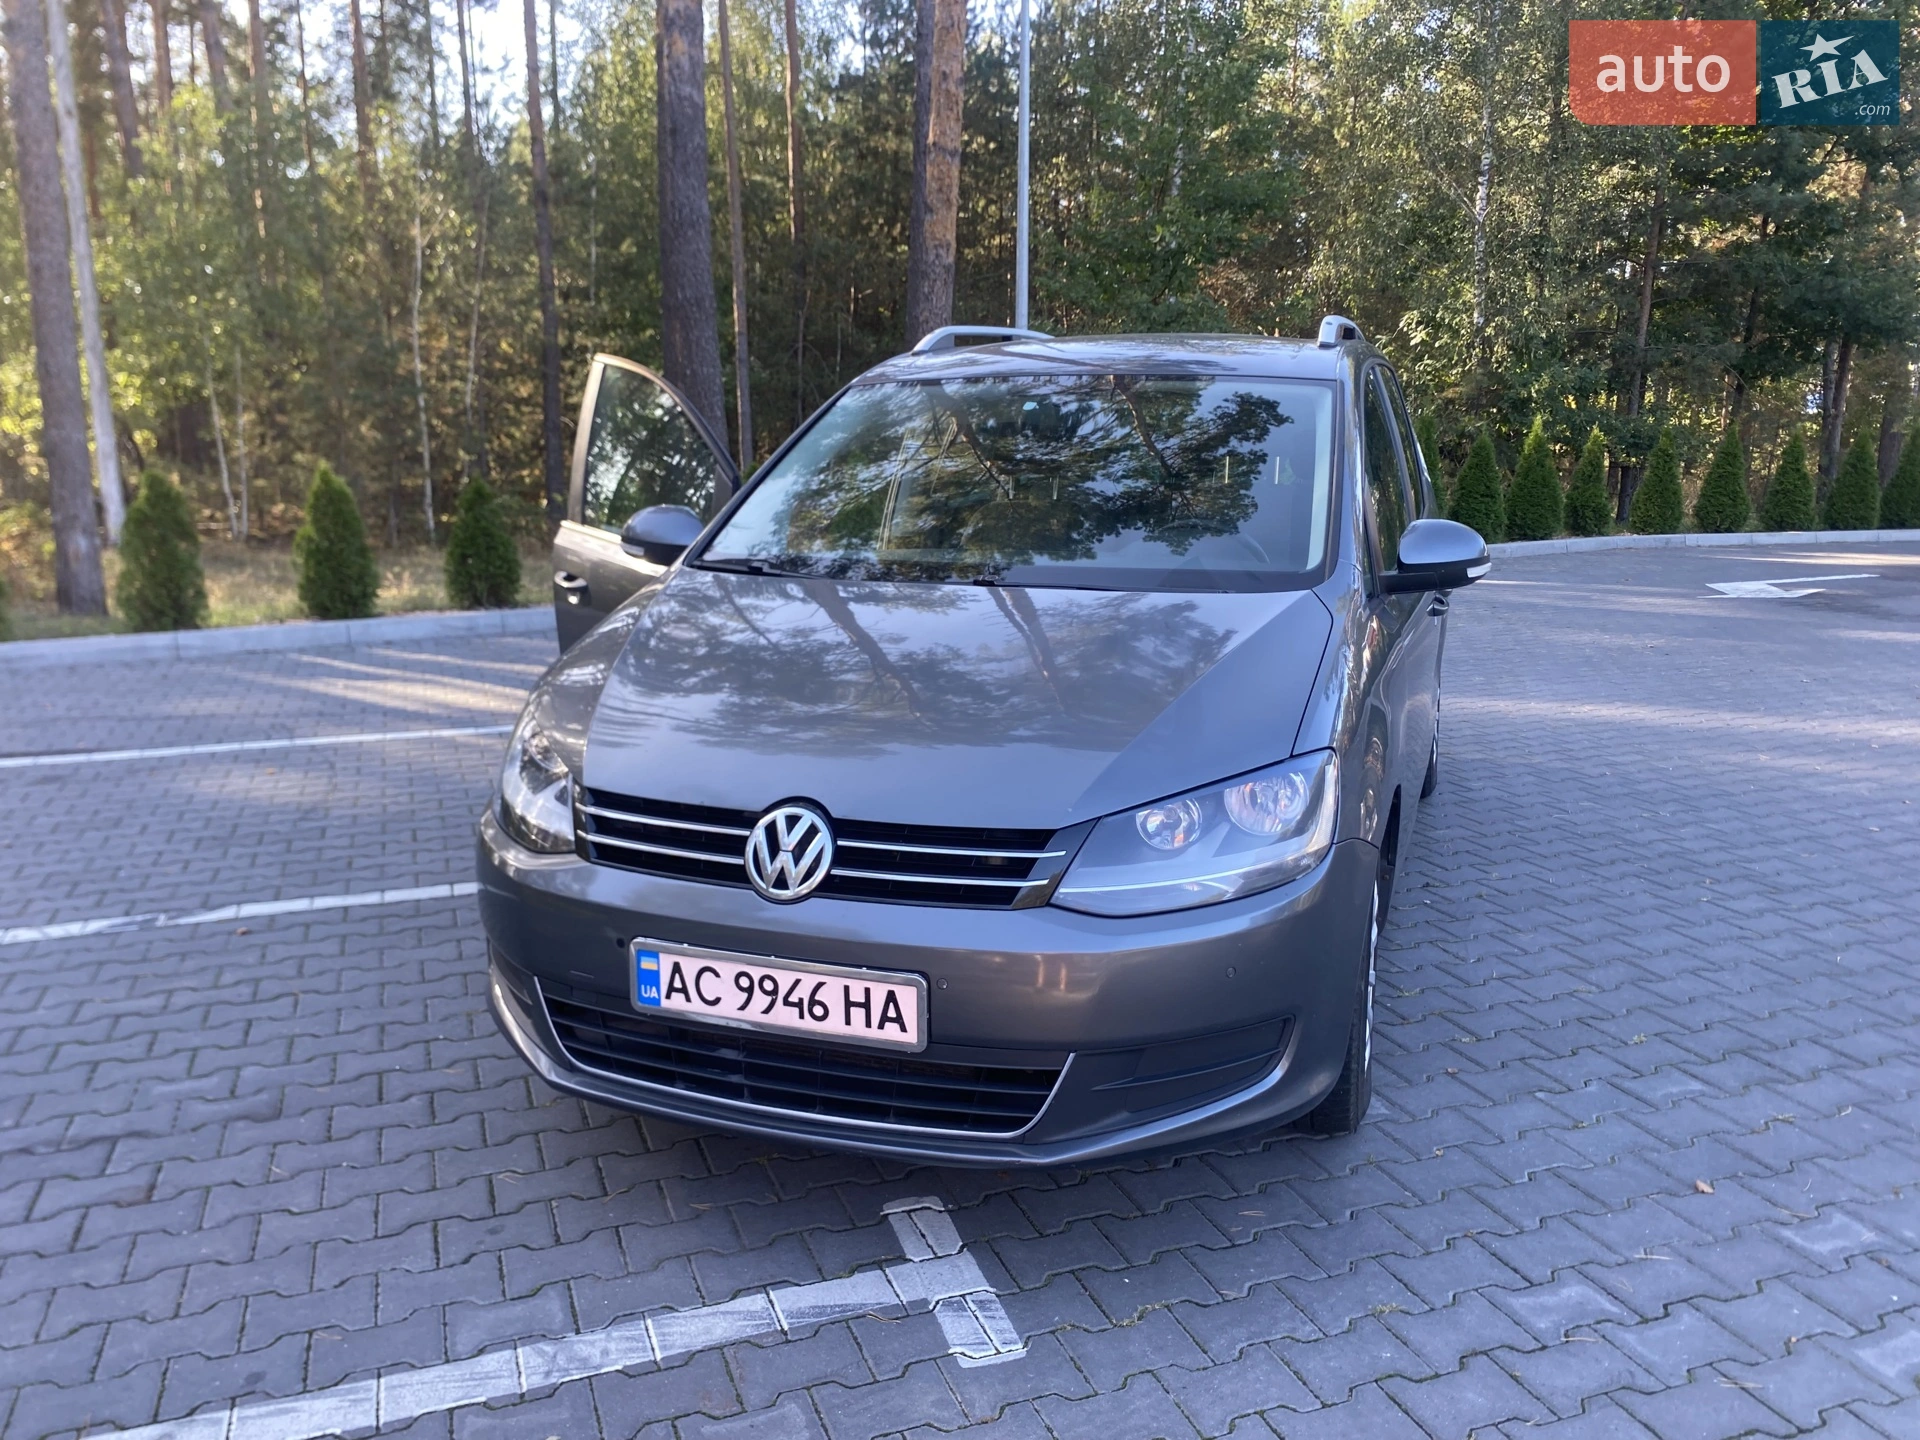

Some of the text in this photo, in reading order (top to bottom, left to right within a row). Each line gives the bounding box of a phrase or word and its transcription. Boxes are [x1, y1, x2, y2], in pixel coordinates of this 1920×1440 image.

[640, 984, 660, 999] UA
[664, 961, 909, 1033] AC 9946 HA
